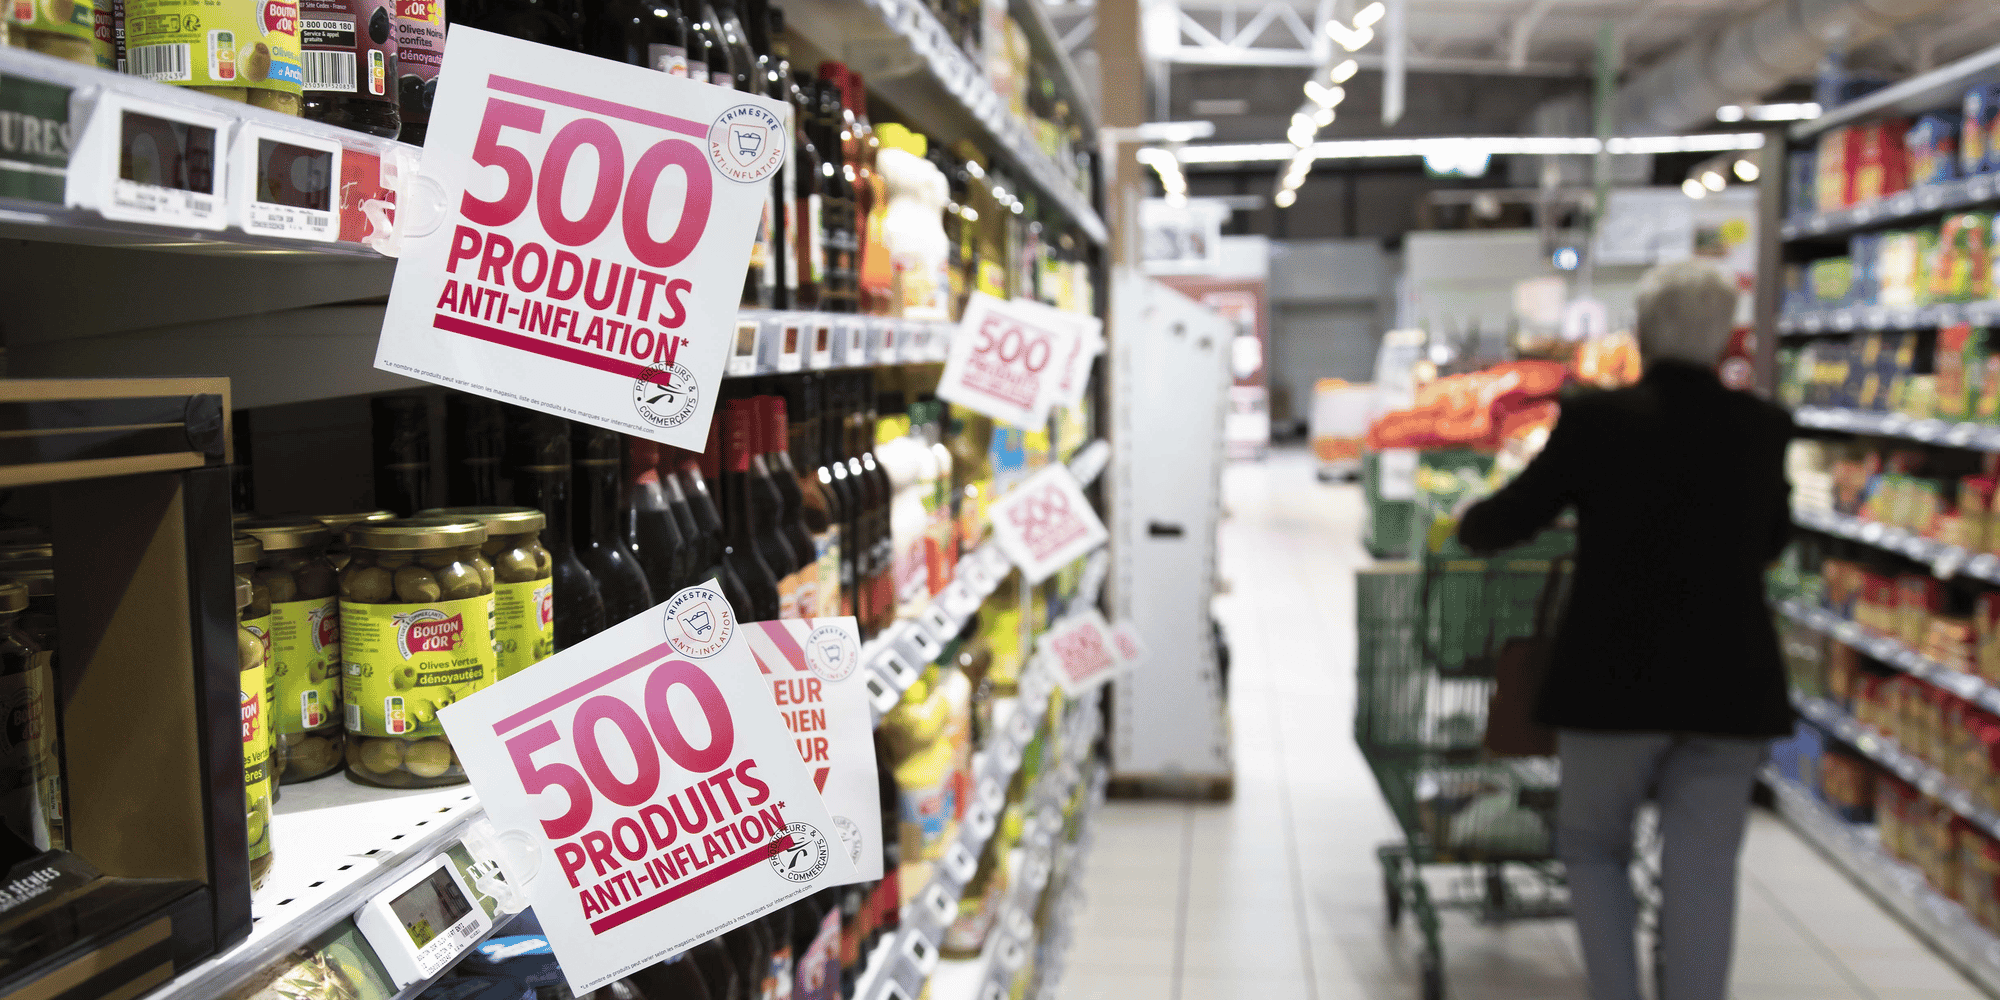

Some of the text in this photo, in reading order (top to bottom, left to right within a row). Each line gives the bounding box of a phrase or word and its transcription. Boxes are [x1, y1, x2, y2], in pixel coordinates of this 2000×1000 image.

[405, 2, 425, 15] d'OR
[323, 21, 337, 29] 008
[339, 22, 352, 30] 180
[399, 24, 425, 36] Olives
[399, 37, 432, 47] confites
[720, 108, 778, 131] TRIMESTRE
[712, 142, 780, 179] ANTI-INFLATION
[459, 97, 713, 268] 500
[445, 224, 692, 329] PRODUITS
[972, 315, 1051, 374] 500
[636, 363, 691, 392] PRODUCTEURS
[393, 363, 413, 371] nombre
[421, 371, 441, 379] produits
[493, 389, 517, 399] magasins,
[541, 402, 561, 410] produits
[578, 411, 600, 420] marques
[611, 419, 654, 434] intermarché.com
[639, 397, 696, 426] COMMERÇANTS
[667, 591, 714, 621] TRIMESTRE
[413, 621, 459, 639] BOUTON
[422, 636, 449, 650] d'OR
[672, 611, 730, 655] ANTI-INFLATION
[419, 657, 478, 671] Olives Vertes
[419, 669, 483, 685] dénoyautées
[773, 677, 823, 706] EUR
[504, 660, 735, 840] 500
[554, 758, 770, 889] PRODUITS
[770, 824, 817, 867] PRODUCTEURS &
[787, 838, 827, 881] COMMERÇANTS
[589, 977, 606, 986] nombre
[612, 966, 630, 976] produits
[641, 955, 654, 963] varier
[674, 938, 696, 949] magasins,
[714, 920, 733, 932] produits
[746, 906, 766, 917] marques
[774, 885, 812, 904] intermarché.com
